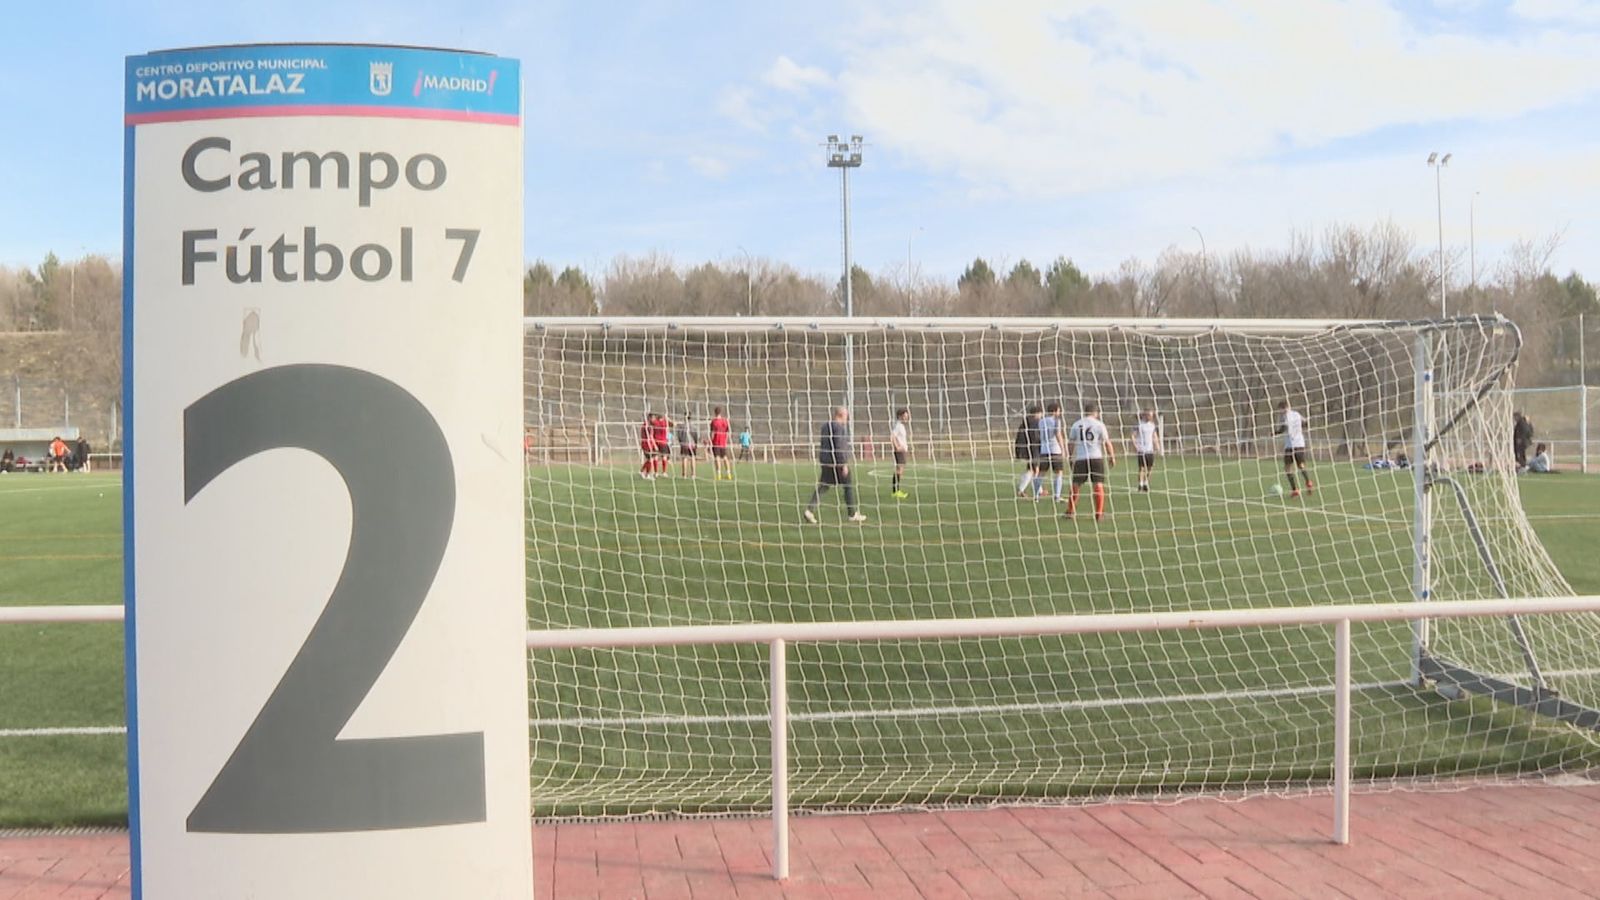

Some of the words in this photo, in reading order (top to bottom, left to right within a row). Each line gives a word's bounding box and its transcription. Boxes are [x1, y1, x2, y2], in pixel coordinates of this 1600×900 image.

[136, 64, 183, 77] CENTRO
[186, 60, 255, 73] DEPORTIVO
[257, 58, 327, 70] MUNICIPAL
[136, 73, 305, 101] MORATALAZ
[182, 137, 447, 207] Campo
[182, 227, 413, 286] Fútbol
[445, 229, 481, 283] 7
[1079, 425, 1095, 441] 16
[183, 363, 487, 835] 2
